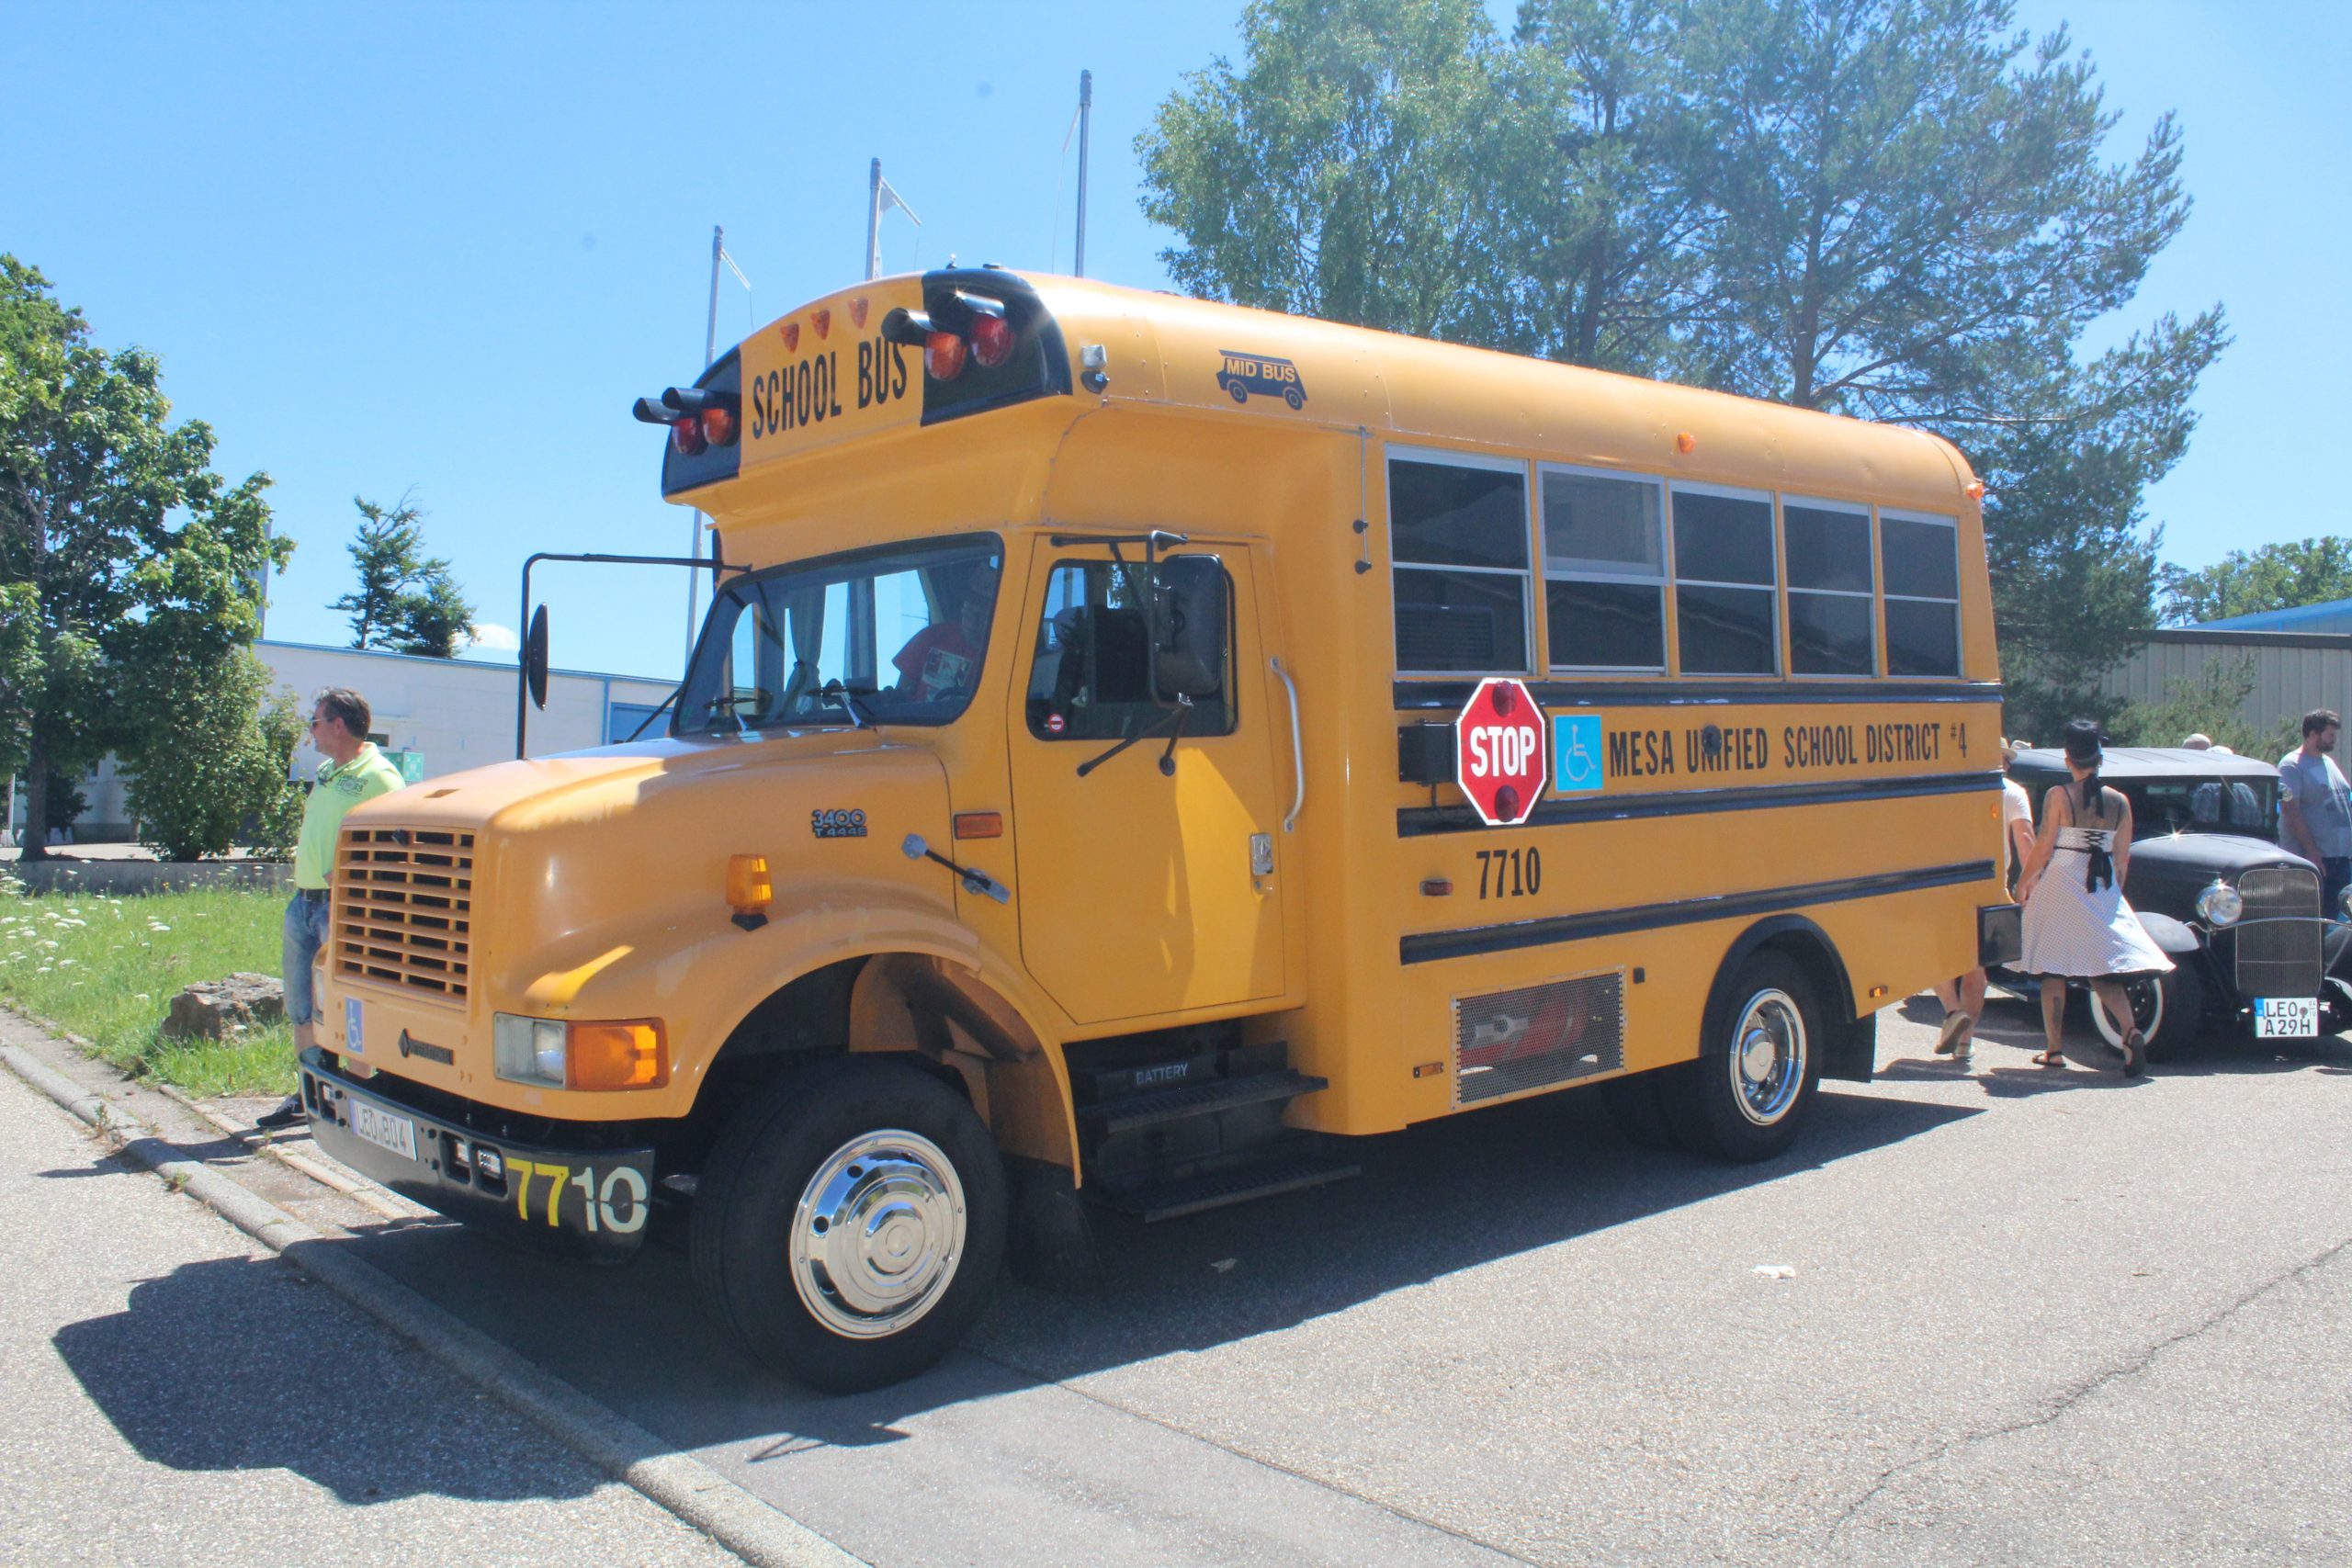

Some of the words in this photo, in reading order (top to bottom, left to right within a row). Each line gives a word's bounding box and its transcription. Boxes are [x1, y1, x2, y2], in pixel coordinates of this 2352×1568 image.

[752, 351, 842, 439] SCHOOL
[858, 336, 907, 410] BUS
[1227, 357, 1258, 378] MID
[1262, 362, 1296, 383] BUS
[1470, 726, 1536, 777] STOP
[1609, 729, 1675, 778] MESA
[1783, 725, 1859, 769] SCHOOL
[1866, 722, 1941, 764] DISTRICT
[811, 809, 867, 828] 3400
[1476, 846, 1542, 900] 7710
[2265, 1000, 2299, 1018] LEO
[2265, 1019, 2311, 1036] A29H
[1136, 1062, 1189, 1086] BATTERY
[505, 1157, 648, 1234] 7710
